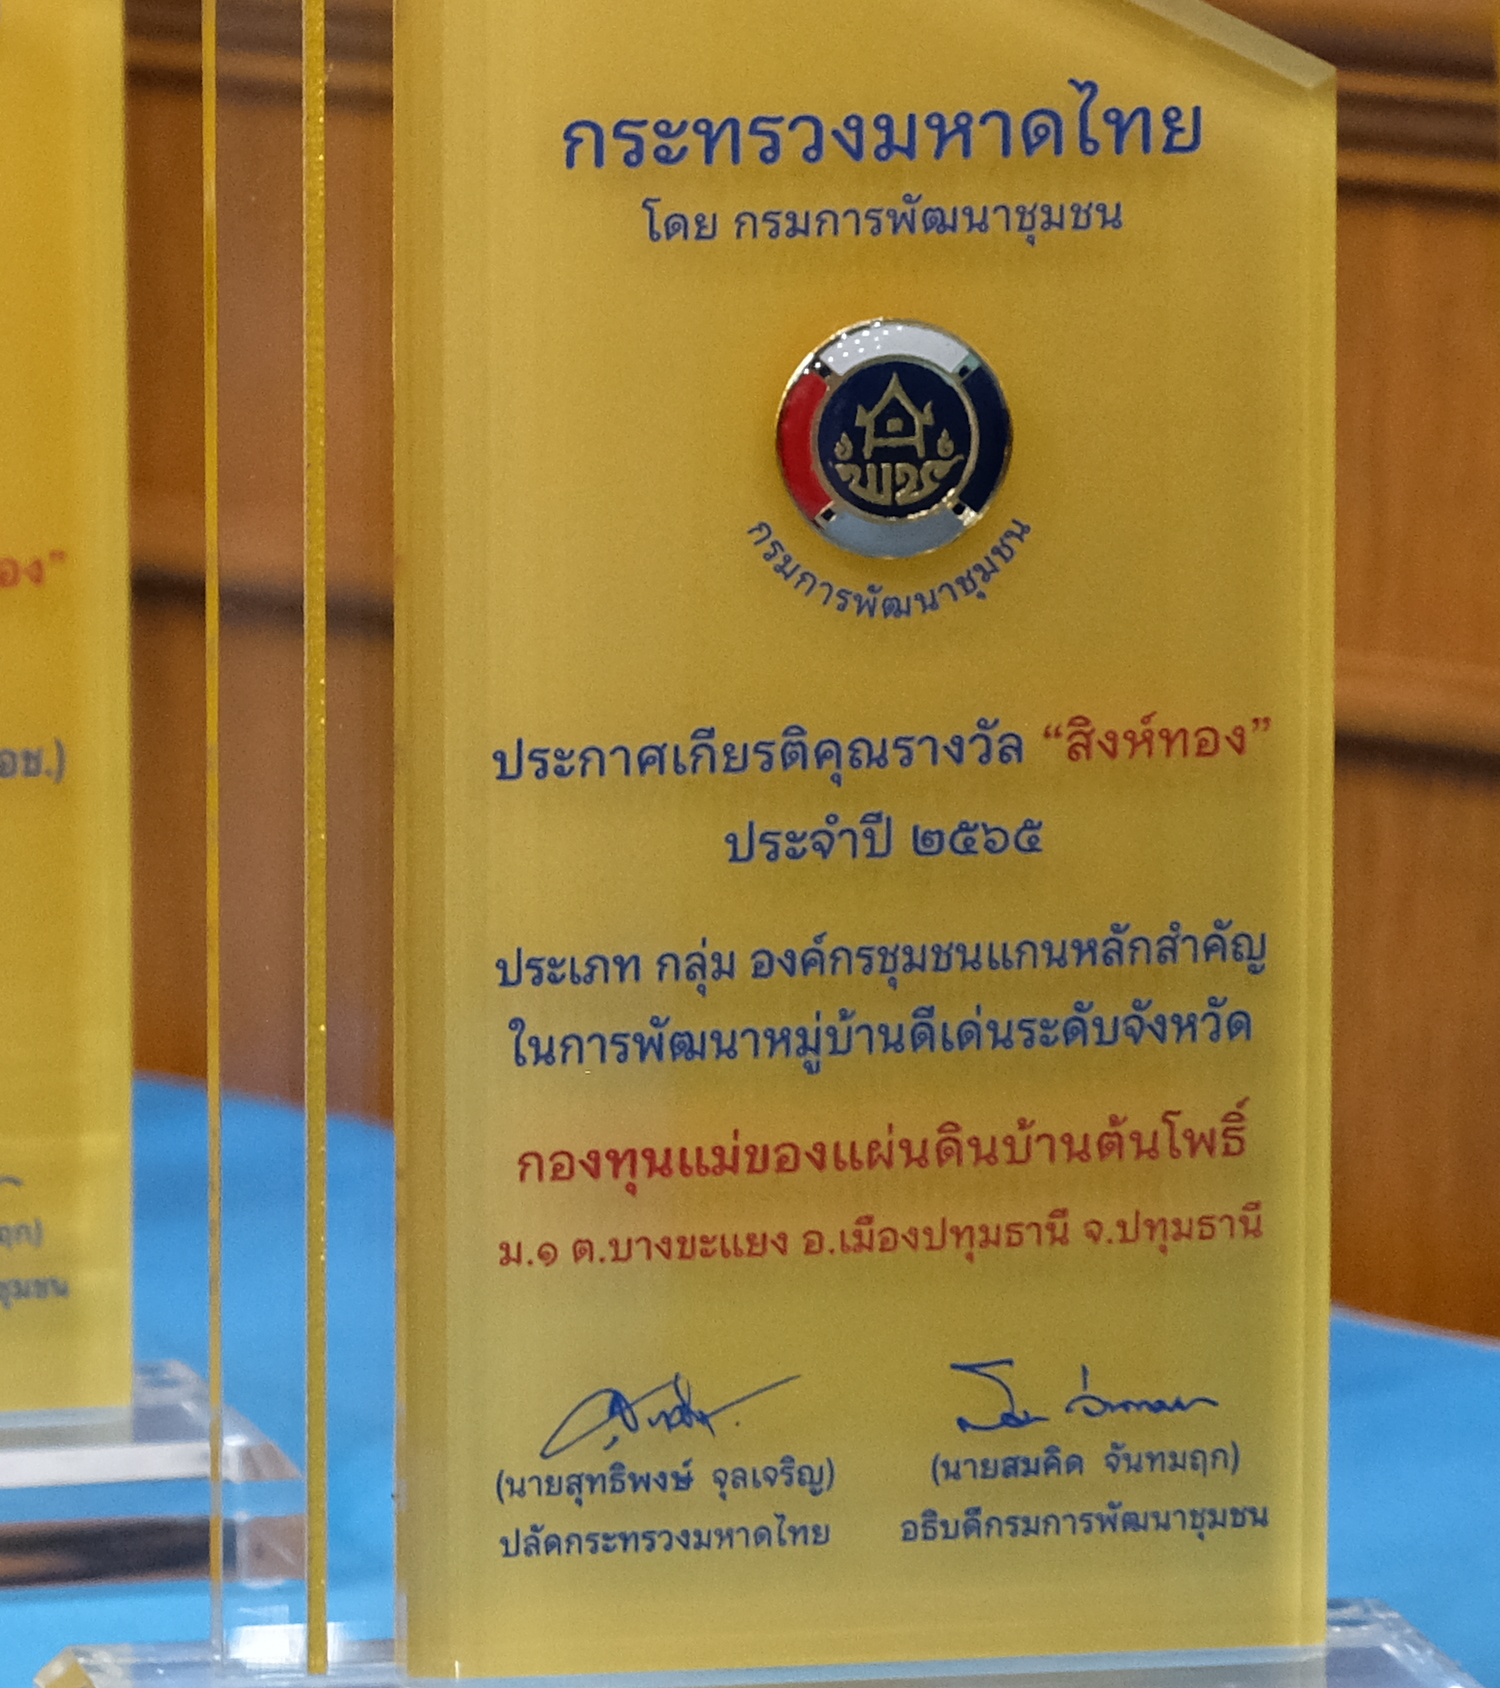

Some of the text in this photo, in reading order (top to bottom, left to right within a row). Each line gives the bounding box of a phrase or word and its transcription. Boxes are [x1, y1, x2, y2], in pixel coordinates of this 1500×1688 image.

[562, 77, 1204, 171] กระทรวงมหาดไทย
[640, 191, 1125, 248] โดย กรมการพัฒนาชุมชน
[746, 517, 1033, 620] กรมการพัฒนาชุมชน
[491, 710, 1273, 789] ประกาศเกียรติคุณรางวัล “สิงห์ทอง”
[723, 808, 1045, 865] ประจำปี ๒๕๖๕
[494, 916, 1269, 996] ประเภท กลุ่ม องค์กรชุมชนแกนหลักสำคัญ
[506, 994, 1254, 1077] ในการพัฒนาหมู่บ้านดีเด่นระดับจังหวัด
[516, 1095, 1251, 1198] กองทุนแม่ของแผ่นดินบ้านต้นโพธิ์
[498, 1200, 1265, 1268] ม.๑ ต.บางขะแยง อ.เมืองปทุมธานี จ.ปทุมธานี
[494, 1453, 837, 1508] (นายสุทธิพงษ์ จุลเจริญ)
[930, 1439, 1242, 1487] (นายสมคิด จันทมฤก)
[498, 1511, 832, 1559] ปลัดกระทรวงมหาดไทย
[899, 1499, 1270, 1544] อธิบดีกรมการพัฒนาชุมชน
